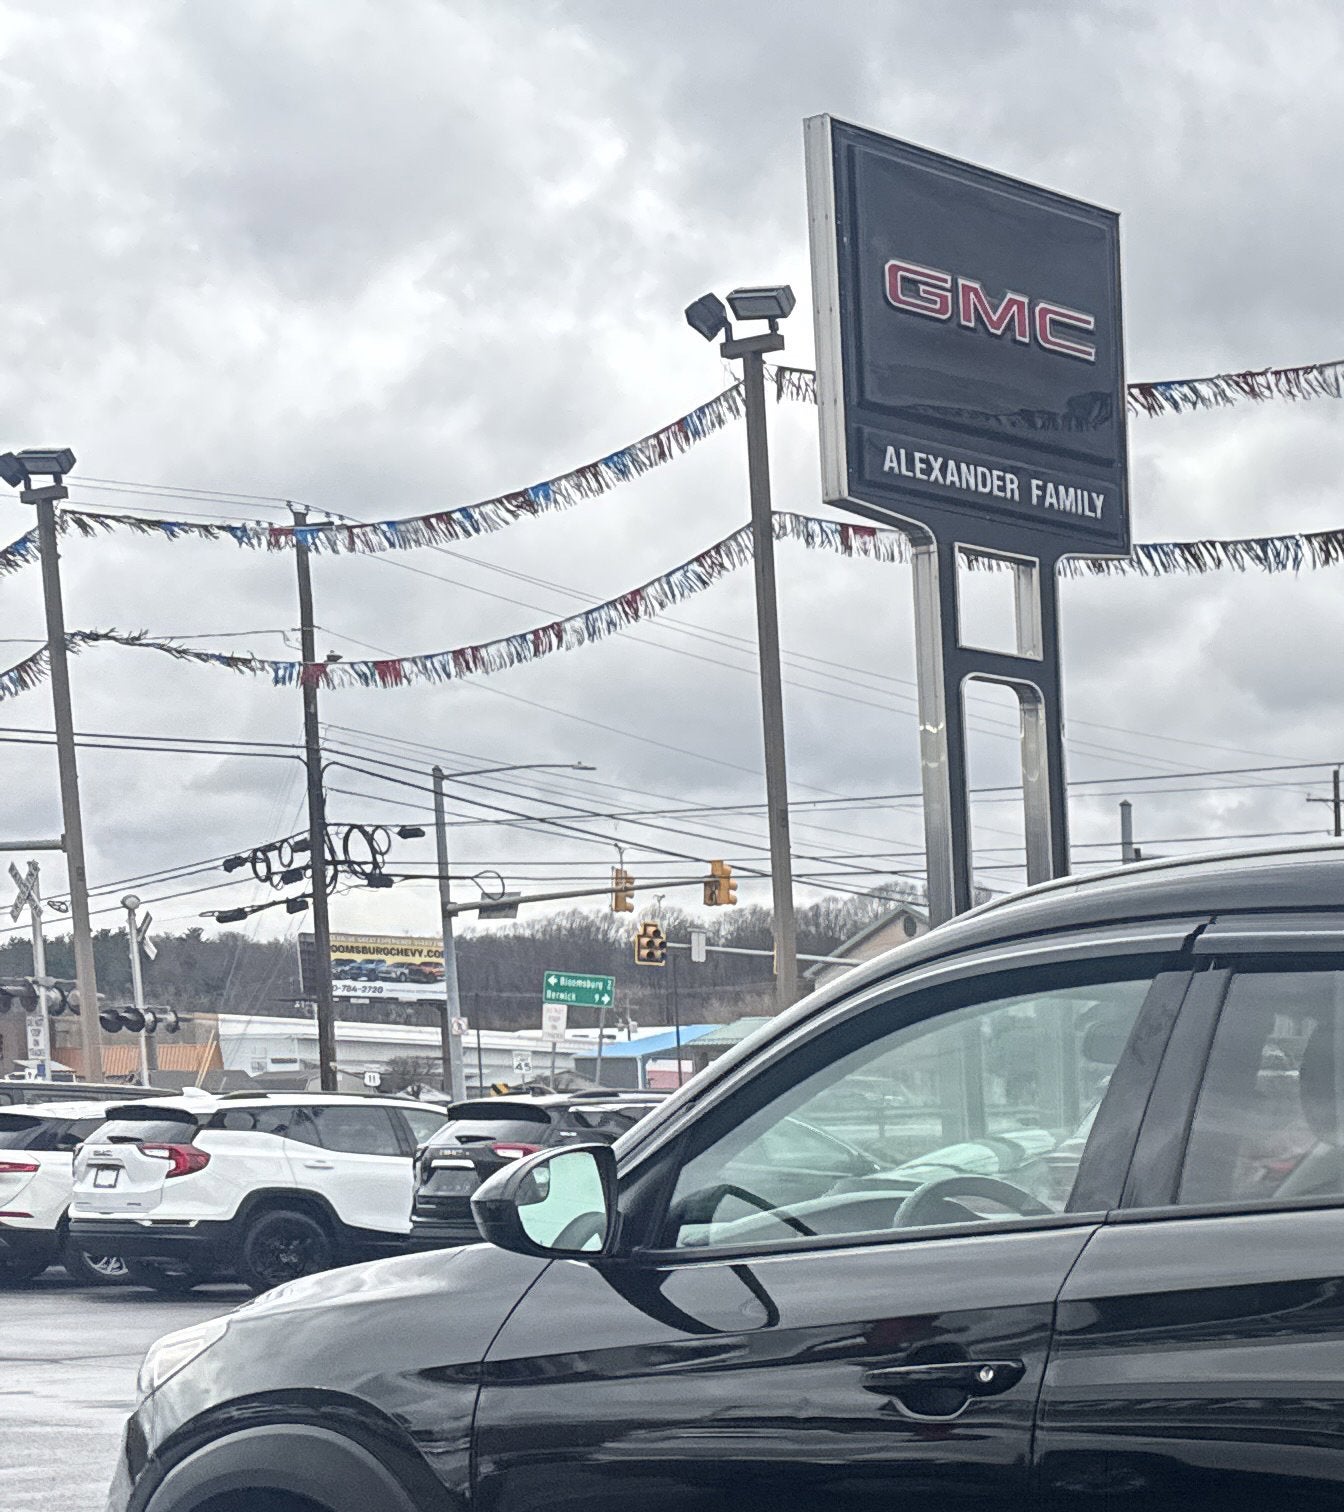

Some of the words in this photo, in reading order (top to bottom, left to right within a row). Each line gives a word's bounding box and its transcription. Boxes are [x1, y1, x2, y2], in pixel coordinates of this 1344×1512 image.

[885, 259, 1095, 361] GMC
[884, 445, 1020, 501] ALEXANDER
[1031, 479, 1104, 519] FAMILY
[329, 944, 445, 959] OOMSBURGCHEVY.CO
[515, 1062, 531, 1072] 45
